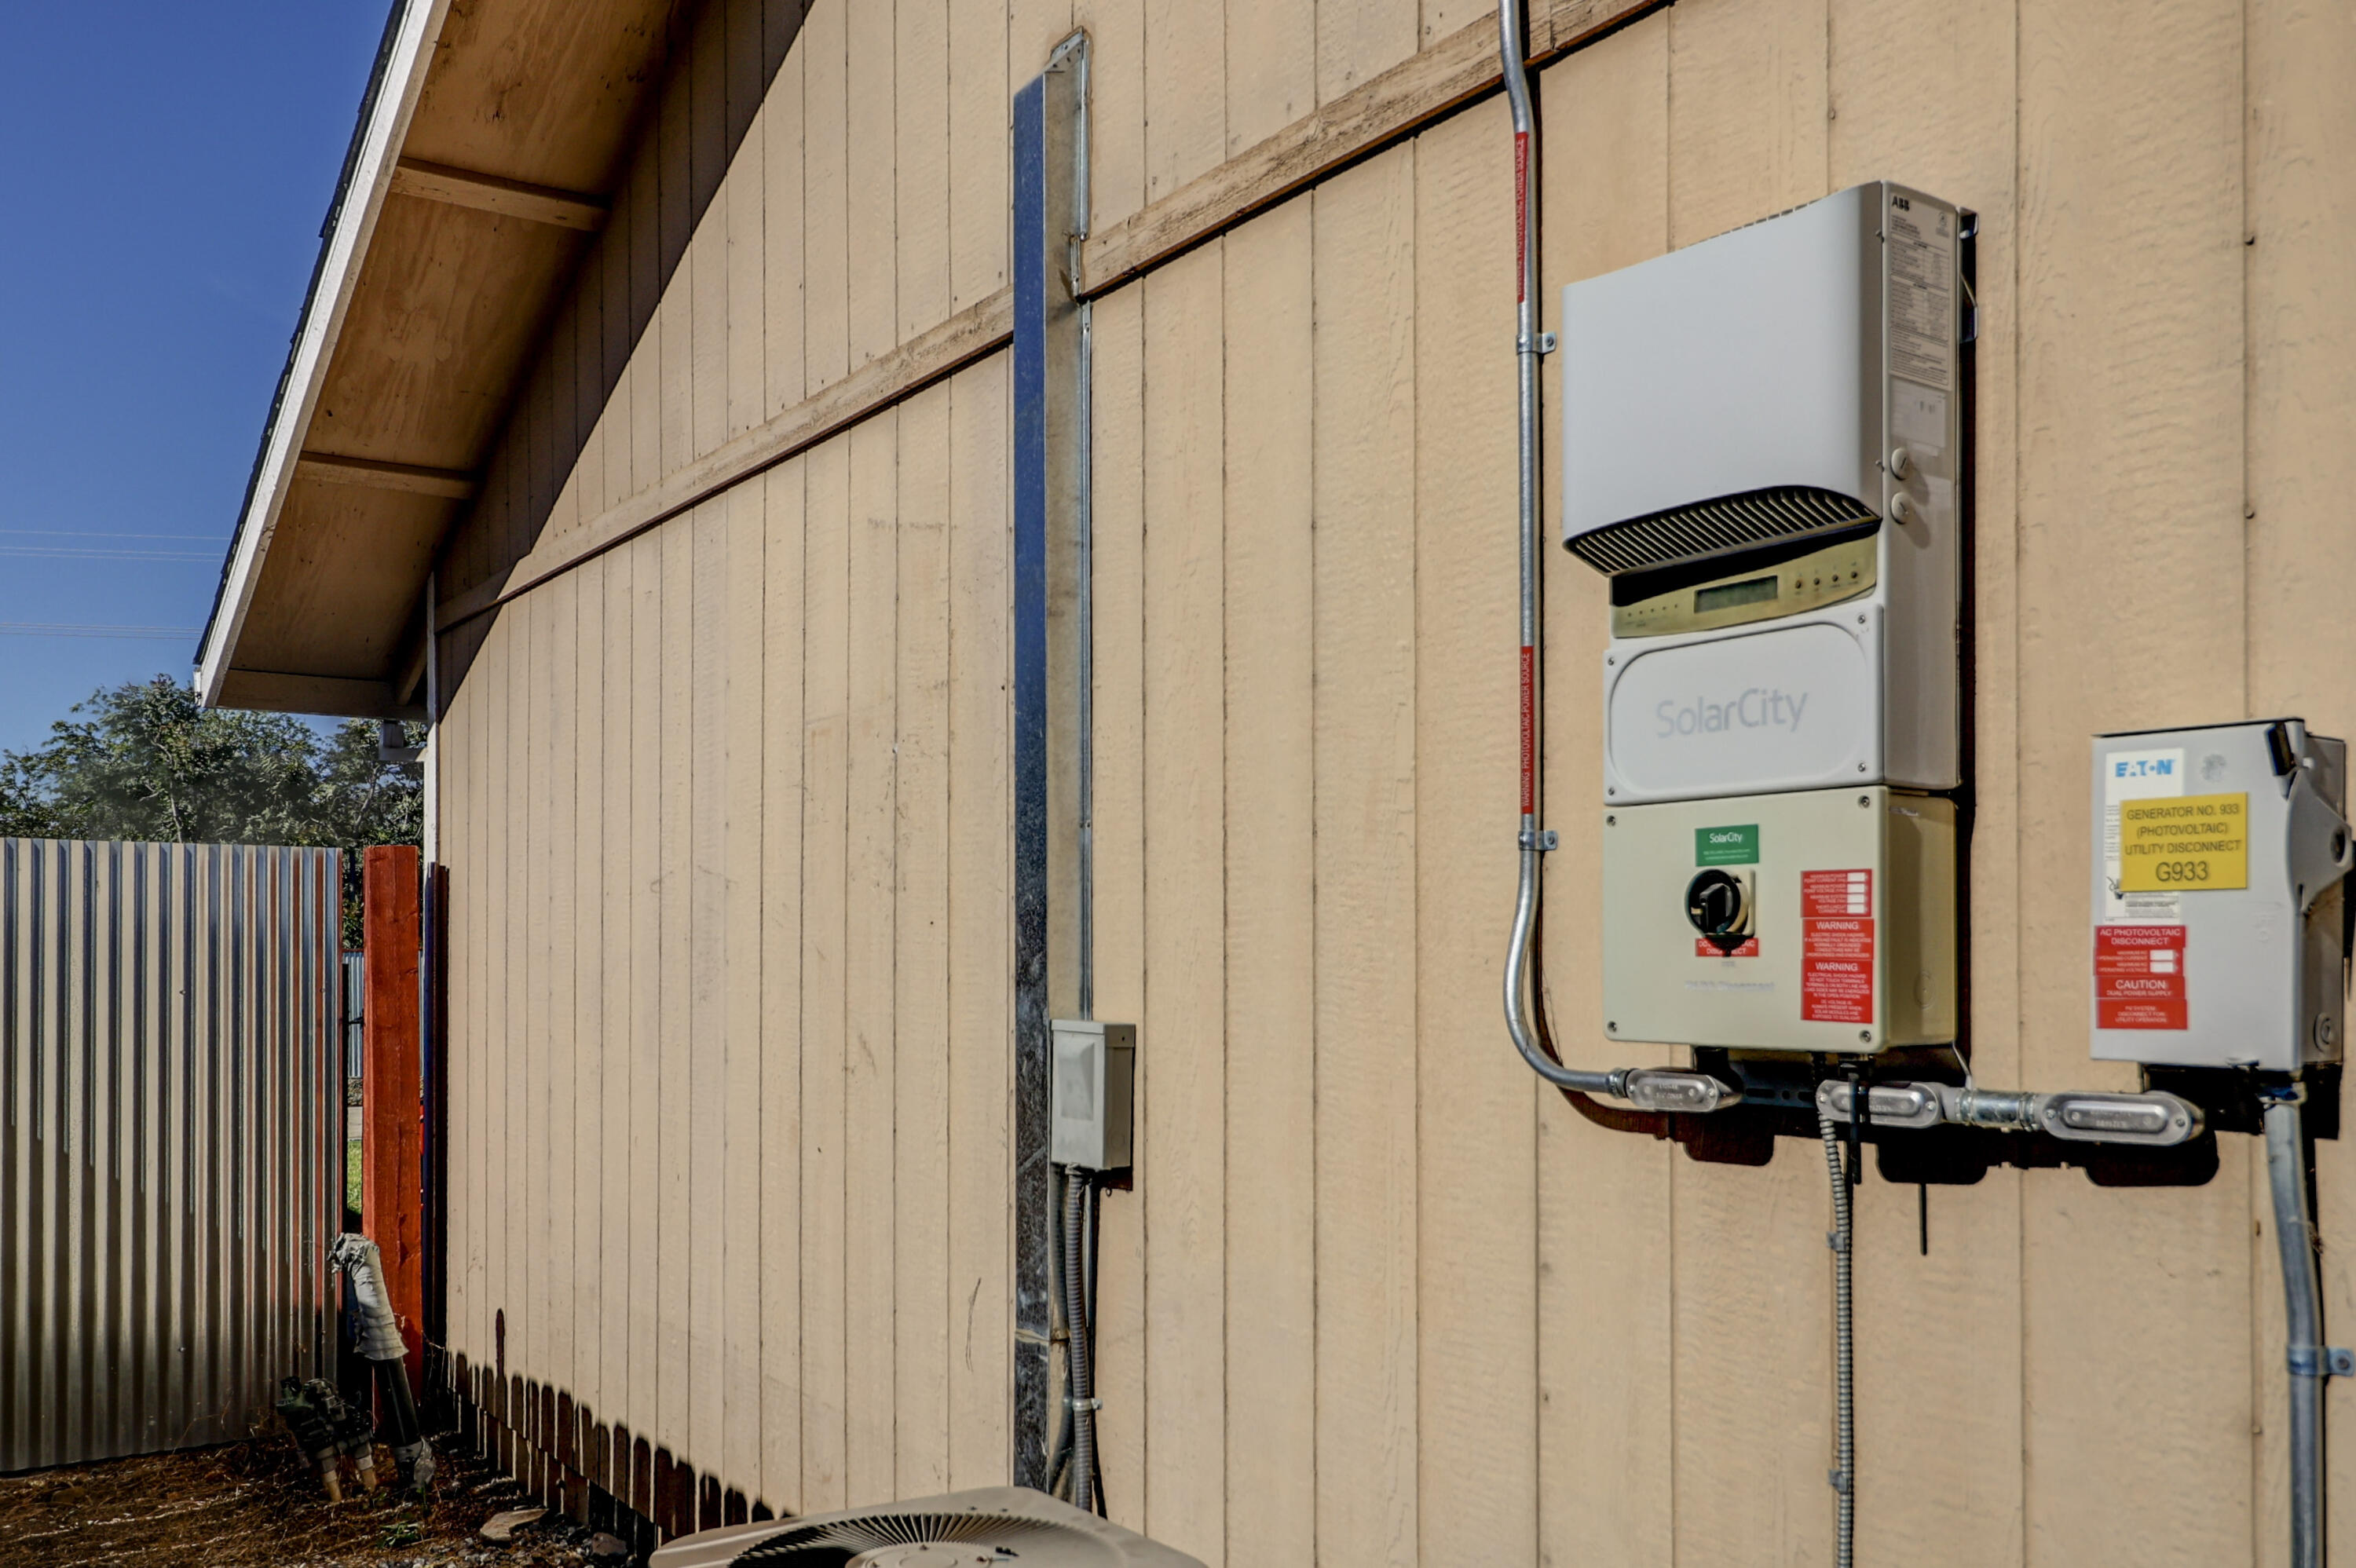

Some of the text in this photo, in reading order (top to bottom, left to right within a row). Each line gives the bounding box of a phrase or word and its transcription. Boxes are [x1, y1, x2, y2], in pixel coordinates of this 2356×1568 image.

[1892, 196, 1910, 212] ABB
[1521, 653, 1530, 684] SOURCE
[1521, 685, 1530, 713] POWER
[1655, 687, 1809, 739] SolarCity
[1521, 714, 1530, 769] PHOTOVOLTAIC
[2127, 803, 2240, 821] GENERATOR NO. 933
[1709, 832, 1743, 843] SolarCity
[2136, 822, 2228, 839] (PHOTOVOLTAIC)
[2125, 839, 2241, 855] UTILITY DISCONNECT
[2155, 861, 2209, 882] G933
[1816, 921, 1859, 930] WARNING
[2113, 928, 2181, 937] PHOTOVOLTAIC
[1815, 962, 1858, 971] WARNING
[2116, 979, 2167, 989] CAUTION
